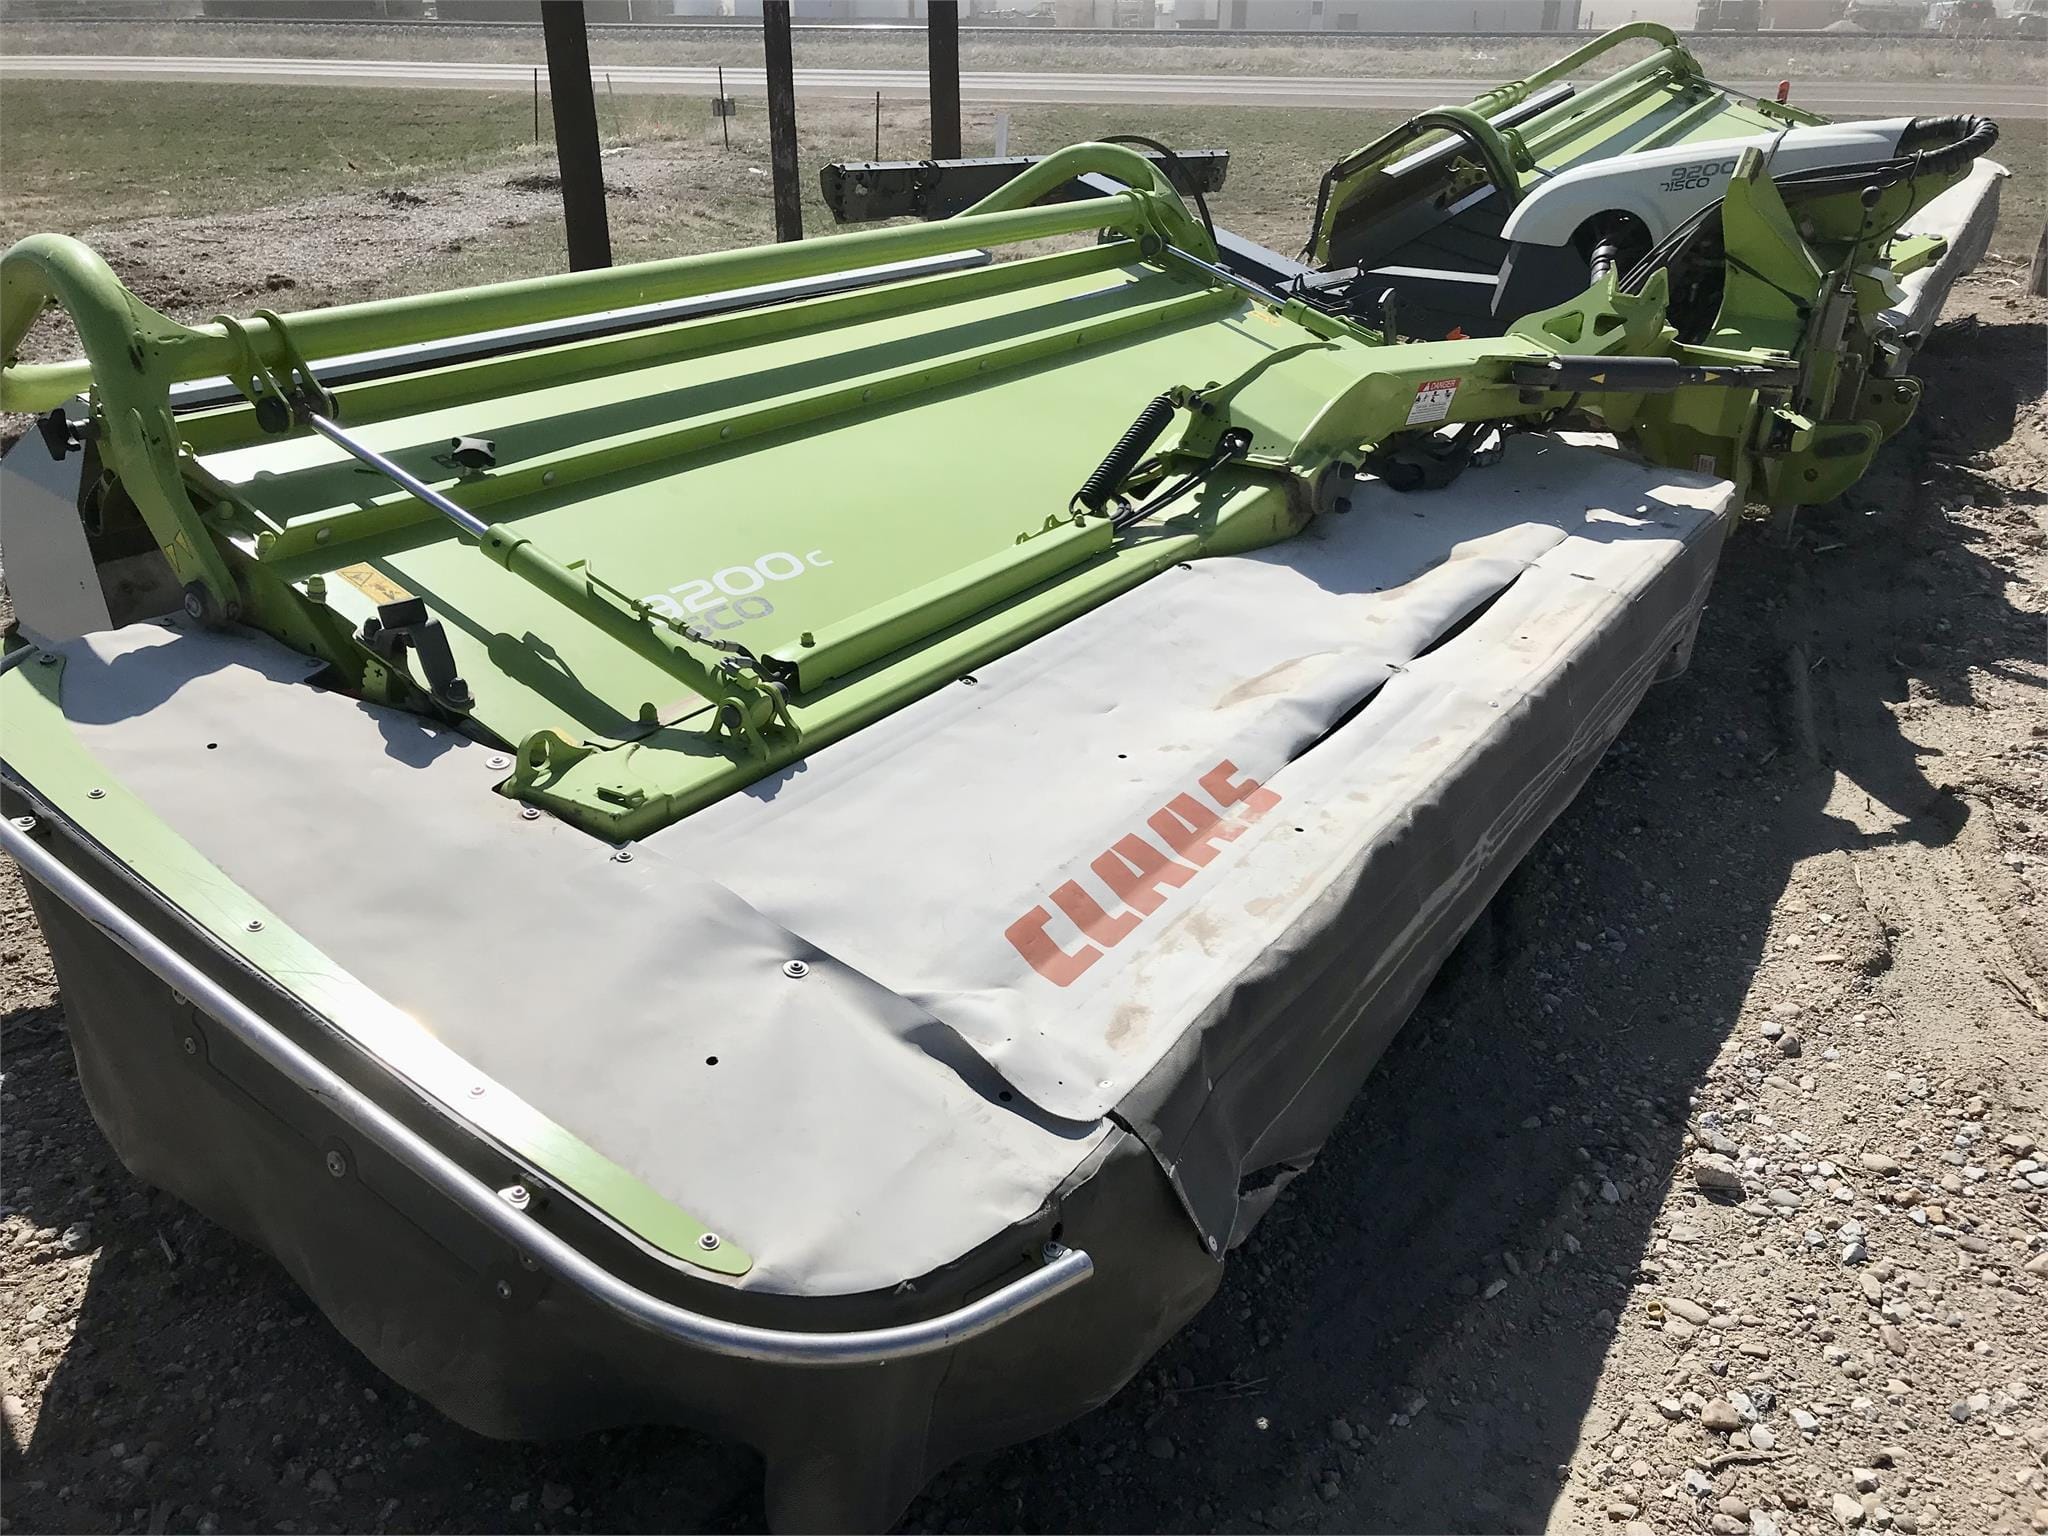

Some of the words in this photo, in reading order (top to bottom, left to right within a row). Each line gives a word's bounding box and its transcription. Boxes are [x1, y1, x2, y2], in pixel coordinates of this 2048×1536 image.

[1671, 161, 1736, 181] 9200
[1430, 379, 1456, 391] DANGER
[641, 552, 805, 626] 9200
[1004, 758, 1282, 987] CLAAS
